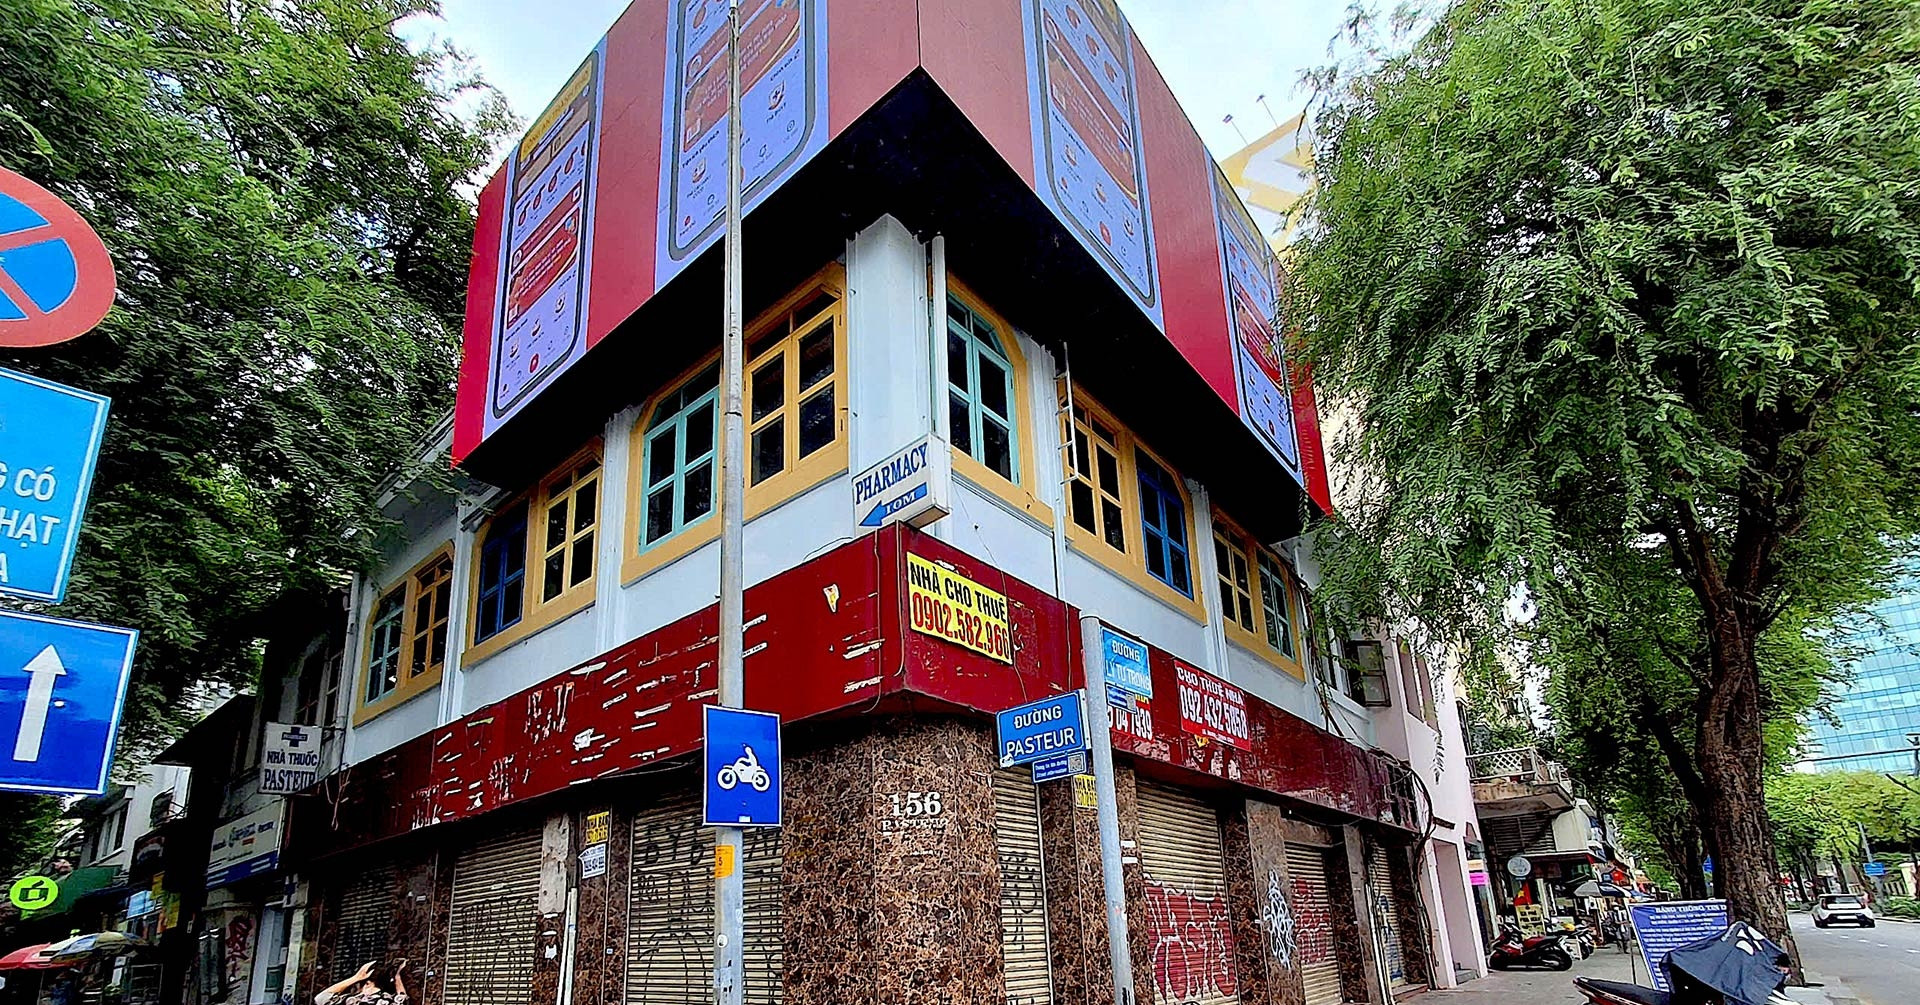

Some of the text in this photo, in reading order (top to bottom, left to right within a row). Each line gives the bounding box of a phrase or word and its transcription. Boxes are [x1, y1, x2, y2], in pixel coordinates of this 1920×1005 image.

[13, 465, 57, 501] CÓ
[855, 442, 928, 505] PHARMACY
[910, 561, 1006, 624] NHÀ CHO THUÊ
[912, 591, 1010, 660] 0902.582.966
[1105, 654, 1115, 678] LÝ
[1111, 639, 1140, 663] ĐƯỜNG
[1176, 667, 1245, 706] CHO THUÊ NHÀ
[1013, 705, 1063, 729] ĐƯỜNG
[266, 748, 318, 766] NHÀ THUỐC
[1006, 727, 1076, 757] PASTEUR
[888, 791, 942, 817] 156
